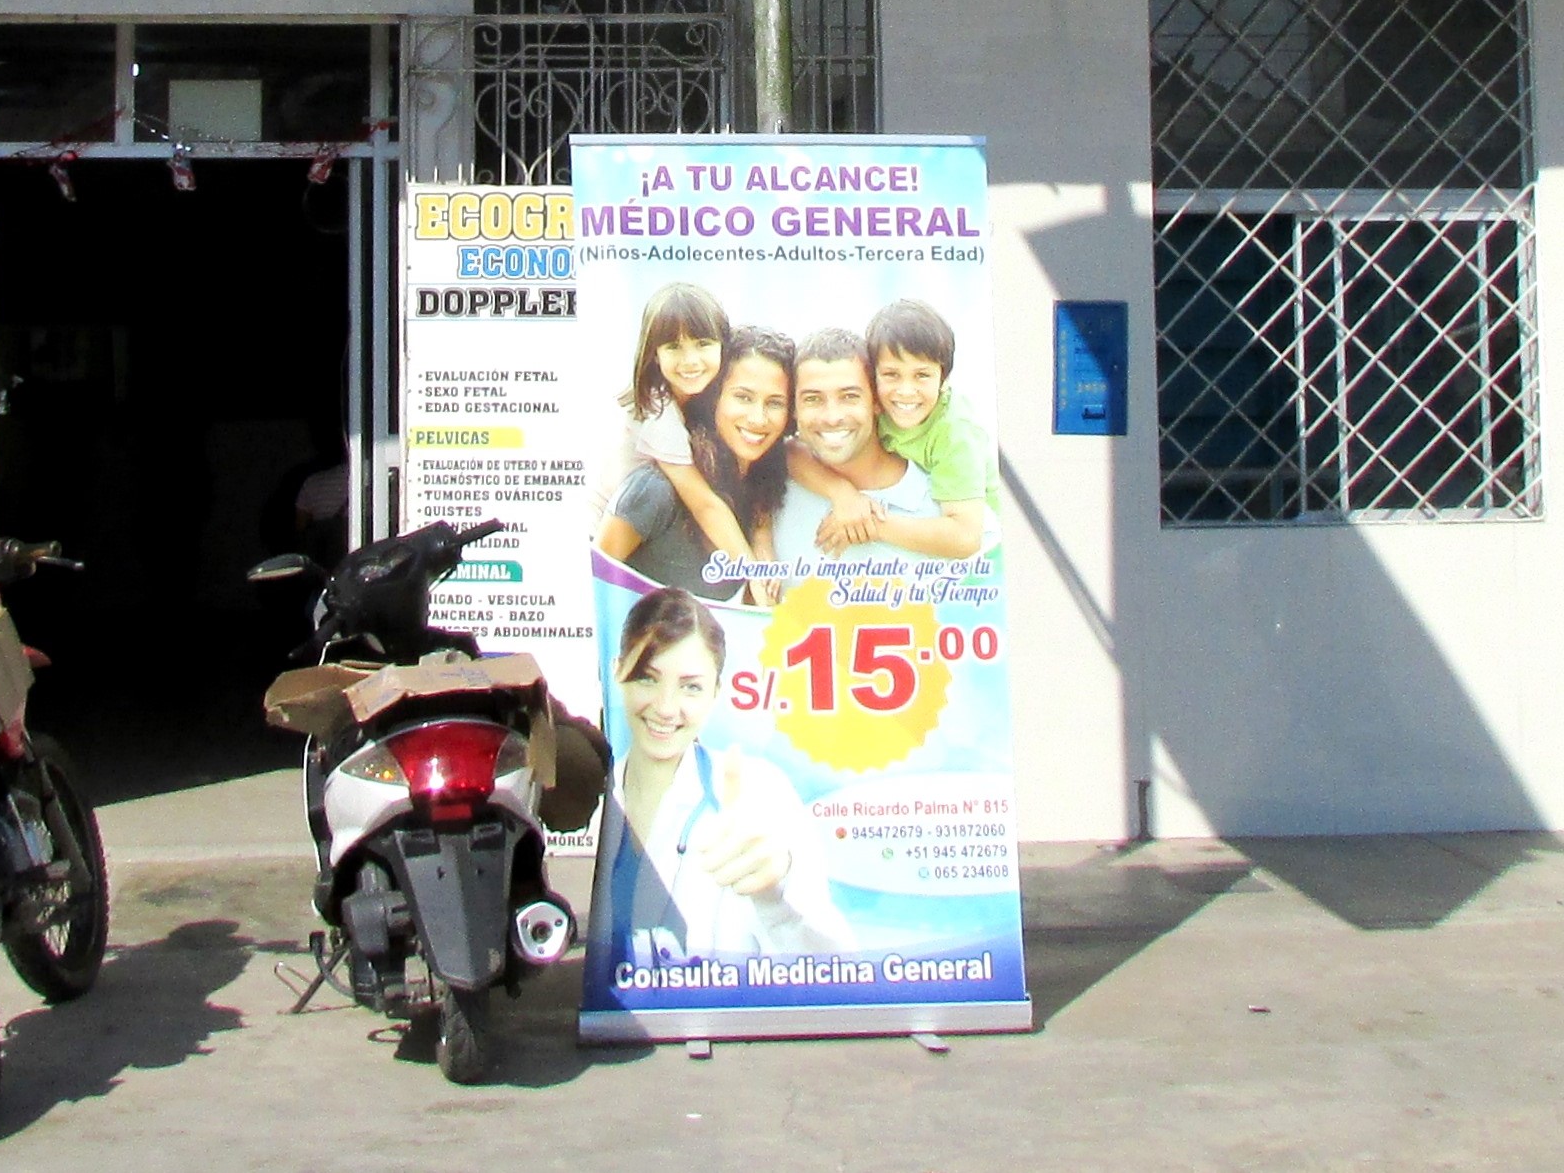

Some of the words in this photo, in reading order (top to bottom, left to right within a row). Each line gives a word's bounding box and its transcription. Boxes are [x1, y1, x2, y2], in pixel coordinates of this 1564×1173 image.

[641, 165, 674, 196] ¡A
[686, 165, 732, 191] TU
[745, 165, 919, 192] ALCANCE!
[581, 198, 755, 237] MÉDICO
[772, 206, 981, 238] GENERAL
[931, 244, 985, 265] Edad)
[457, 245, 576, 279] ECONO
[425, 369, 509, 382] EVALUACIÓN
[514, 371, 558, 382] FETAL
[425, 386, 459, 397] SEXO
[464, 386, 507, 397] FETAL
[425, 402, 460, 413] EDAD
[464, 402, 559, 413] GESTACIONAL
[415, 431, 490, 446] PELVICAS
[422, 457, 483, 471] EVALUACIÓN
[487, 460, 500, 471] DE
[504, 460, 538, 471] UTERO
[541, 460, 547, 470] Y
[423, 472, 500, 486] DIAGNÓSTICO
[504, 475, 520, 485] DE
[424, 490, 489, 501] TUMORES
[495, 488, 563, 501] OVÁRICOS
[424, 506, 483, 518] QUISTES
[704, 552, 789, 580] Sabemos
[794, 556, 811, 577] lo
[816, 556, 910, 579] importante
[915, 562, 945, 582] que
[950, 562, 971, 575] es
[973, 556, 990, 575] tu
[830, 578, 887, 606] Salud
[891, 585, 904, 608] y
[908, 582, 925, 603] tu
[930, 576, 998, 607] Tiempo
[488, 594, 556, 606] VESICULA
[509, 611, 545, 622] BAZO
[493, 627, 593, 638] ABDOMINALES
[812, 802, 848, 817] Calle
[854, 802, 909, 816] Ricardo
[914, 801, 958, 815] Palma
[984, 800, 1009, 813] 815
[852, 825, 923, 839] 945472679
[936, 823, 1006, 837] 931872060
[546, 835, 594, 847] MORES
[905, 845, 928, 859] +51
[933, 845, 957, 858] 945
[961, 844, 1007, 857] 472679
[935, 866, 958, 879] 065
[963, 865, 1009, 878] 234608
[615, 959, 739, 989] Consulta
[748, 956, 874, 986] Medicina
[883, 951, 993, 981] General
